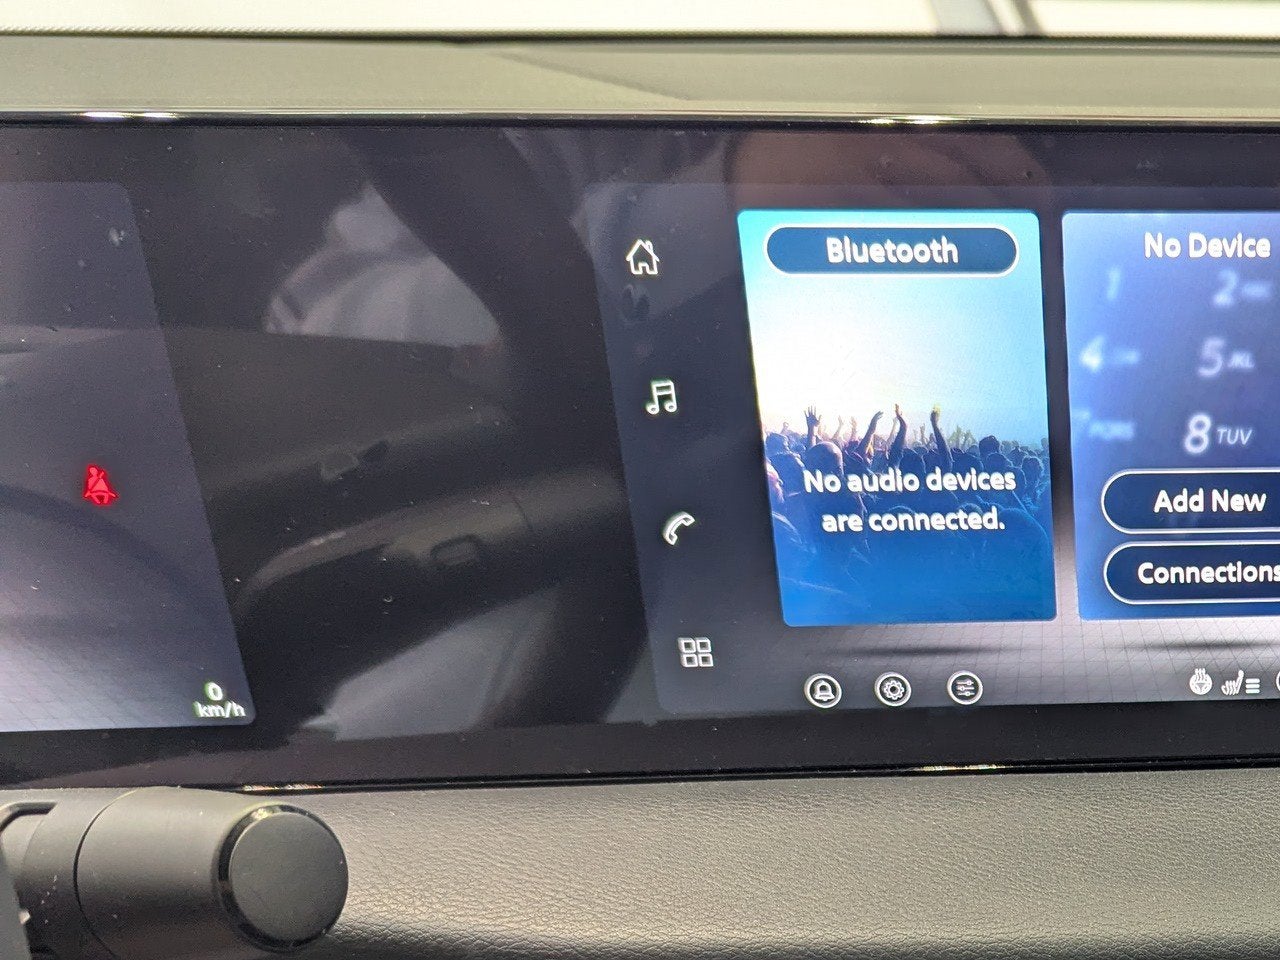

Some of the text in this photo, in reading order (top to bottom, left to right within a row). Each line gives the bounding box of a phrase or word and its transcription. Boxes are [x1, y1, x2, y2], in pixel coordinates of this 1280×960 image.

[826, 237, 959, 264] Bluetooth
[1144, 232, 1271, 258] No Device
[1198, 337, 1226, 378] 5
[1184, 412, 1252, 454] 8 TUV
[803, 466, 1016, 493] No audio devices
[1154, 488, 1267, 513] Add New
[822, 506, 1005, 532] are connected.
[205, 681, 223, 701] 0
[193, 700, 246, 718] km/h
